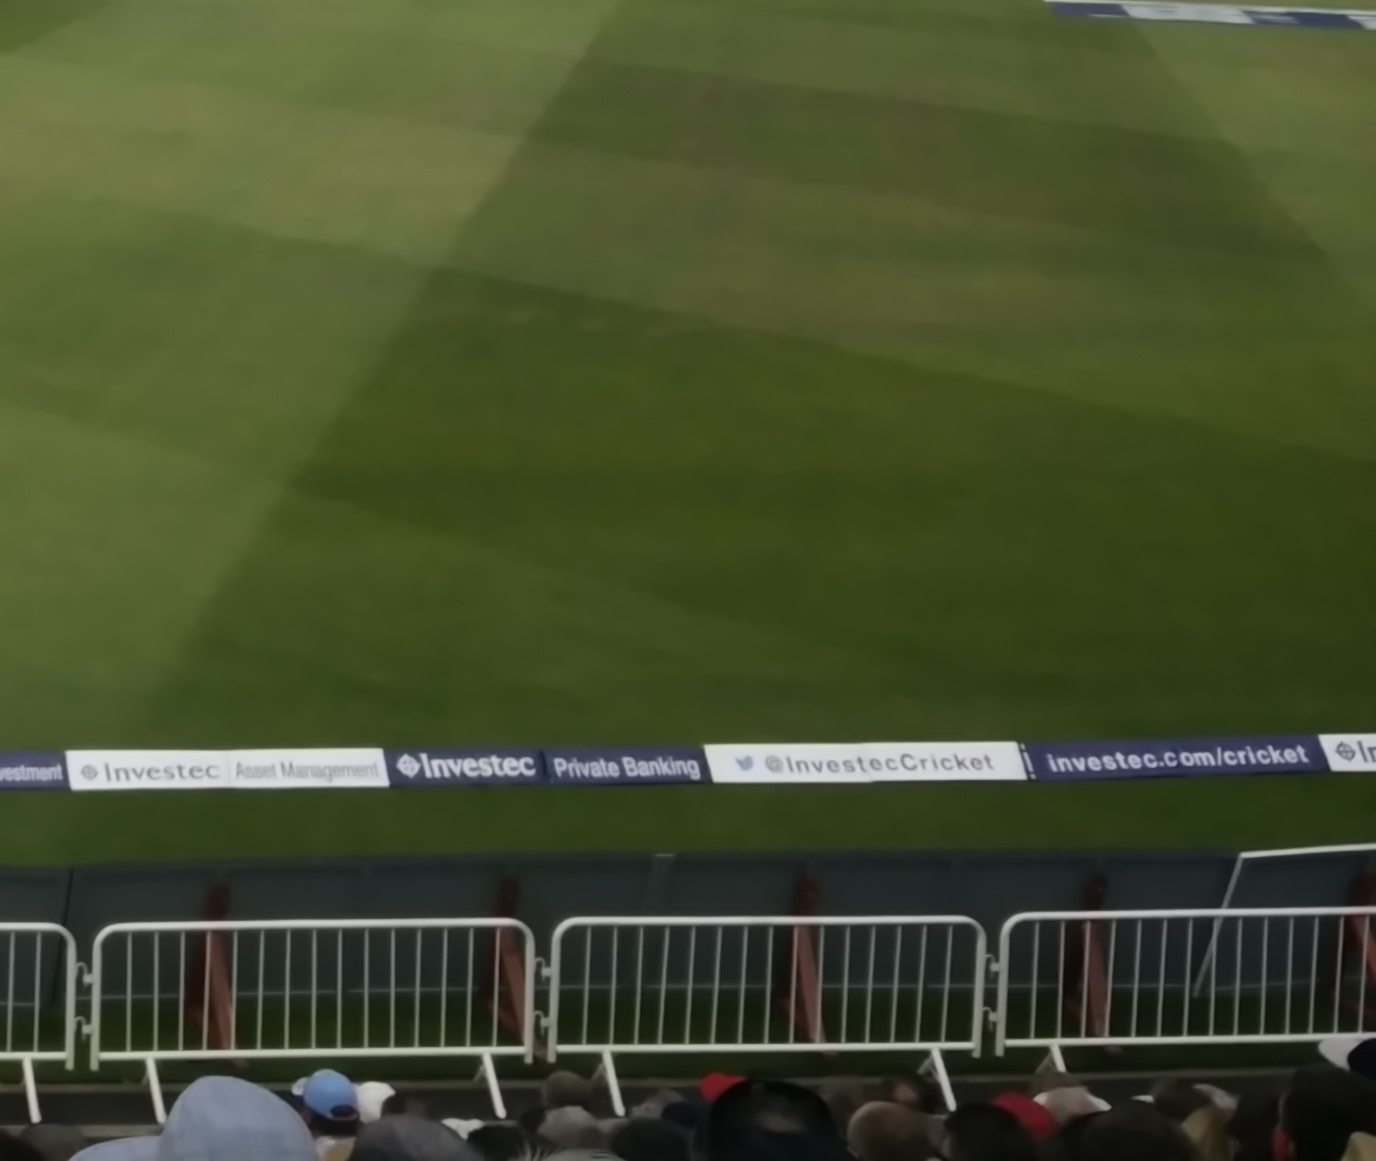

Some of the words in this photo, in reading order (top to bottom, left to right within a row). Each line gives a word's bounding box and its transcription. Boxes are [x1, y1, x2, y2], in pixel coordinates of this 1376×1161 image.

[422, 752, 536, 778] Investec
[554, 757, 619, 777] Private
[624, 756, 701, 778] Banking
[764, 754, 995, 773] @InvestecCricket
[1047, 744, 1309, 773] investec.com/cricket
[104, 762, 220, 782] Investec
[235, 762, 276, 779] Asset
[281, 761, 380, 782] Management
